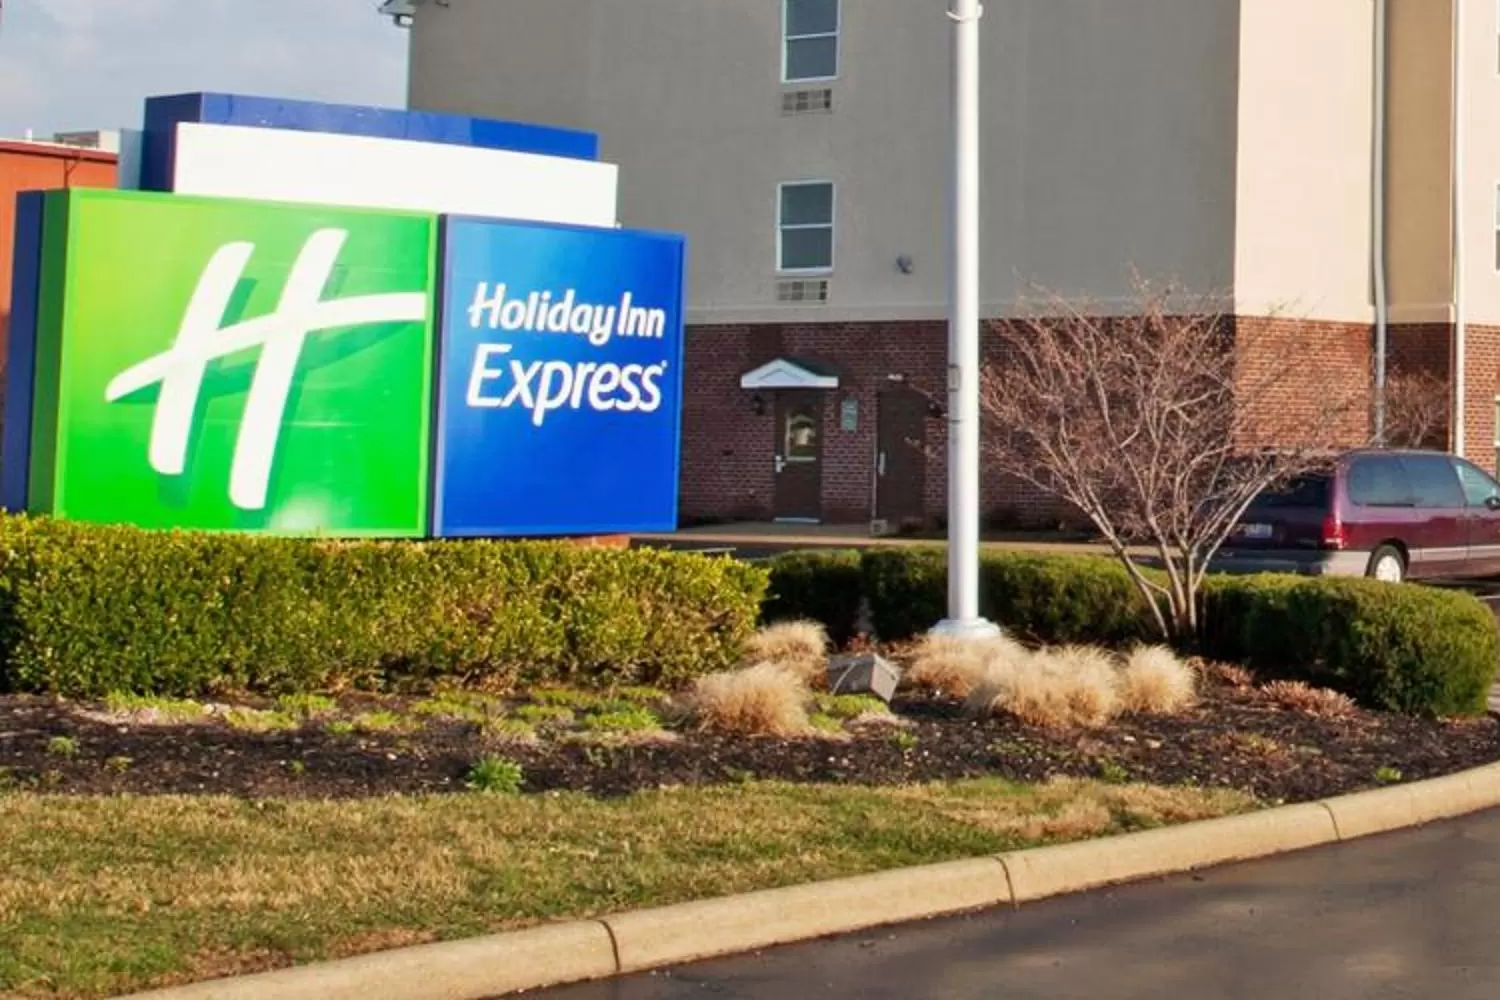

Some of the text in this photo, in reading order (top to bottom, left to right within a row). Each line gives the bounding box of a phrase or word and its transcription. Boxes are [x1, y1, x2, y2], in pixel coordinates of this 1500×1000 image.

[467, 281, 665, 346] Holiday Inn
[104, 227, 427, 510] H
[466, 343, 664, 427] Express
